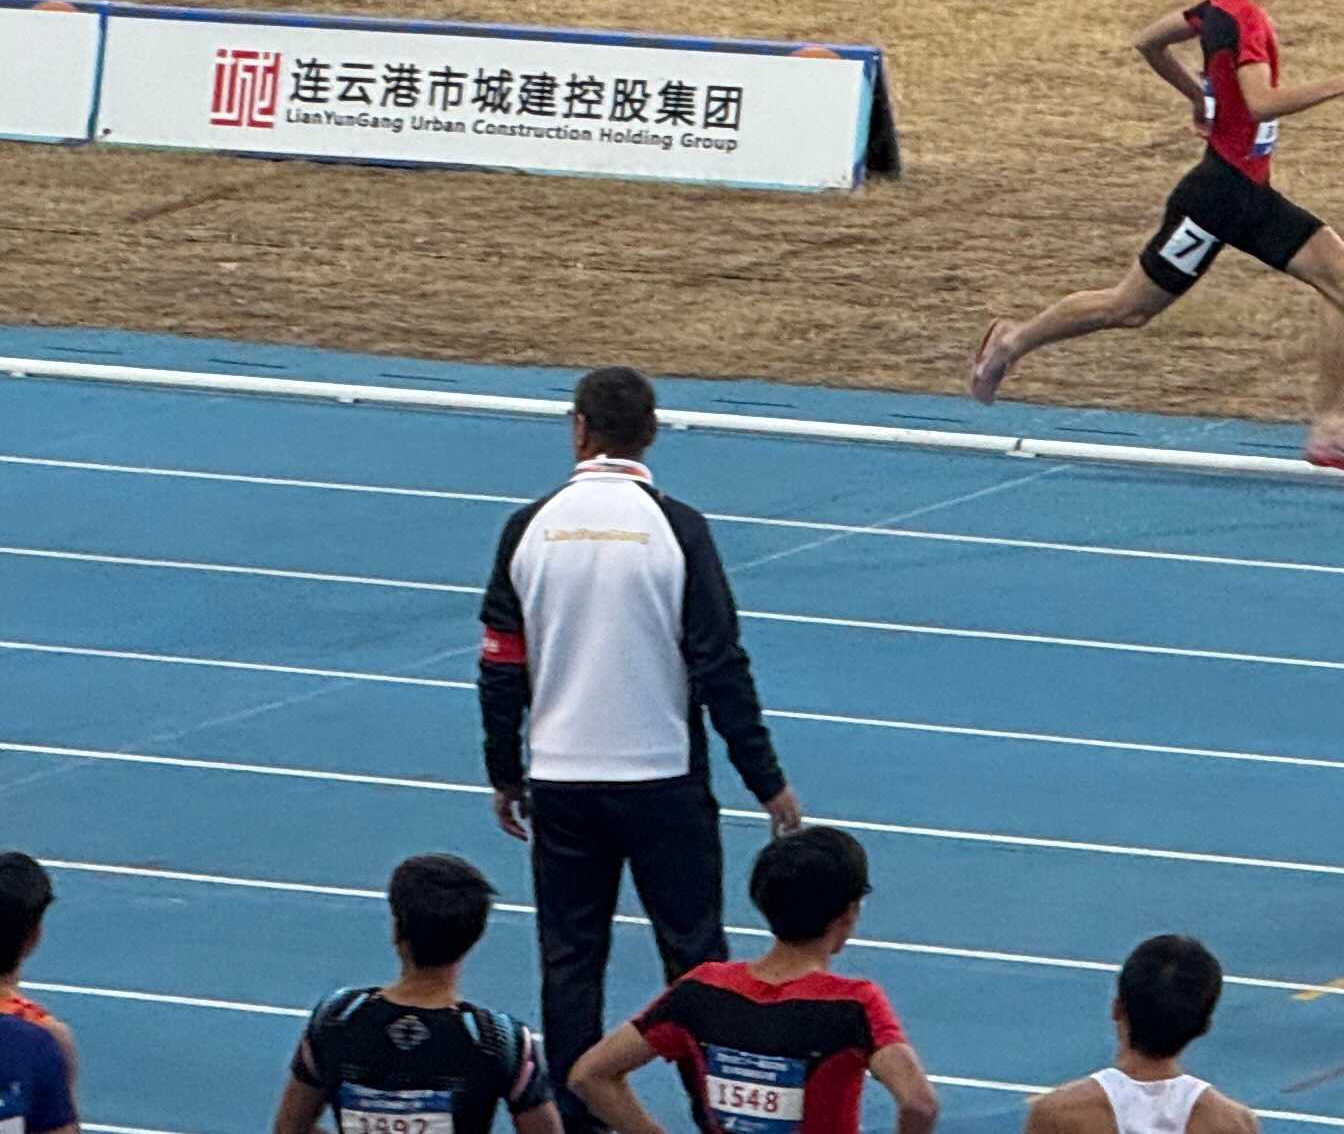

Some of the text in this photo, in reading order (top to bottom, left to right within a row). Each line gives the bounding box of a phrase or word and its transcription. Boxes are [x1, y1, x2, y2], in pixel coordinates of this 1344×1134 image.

[289, 57, 744, 131] 连云港市城建控股集团
[286, 109, 739, 153] LianYunGang Urban Construction Holding Group
[1175, 229, 1204, 258] 7
[717, 1083, 779, 1113] 1548
